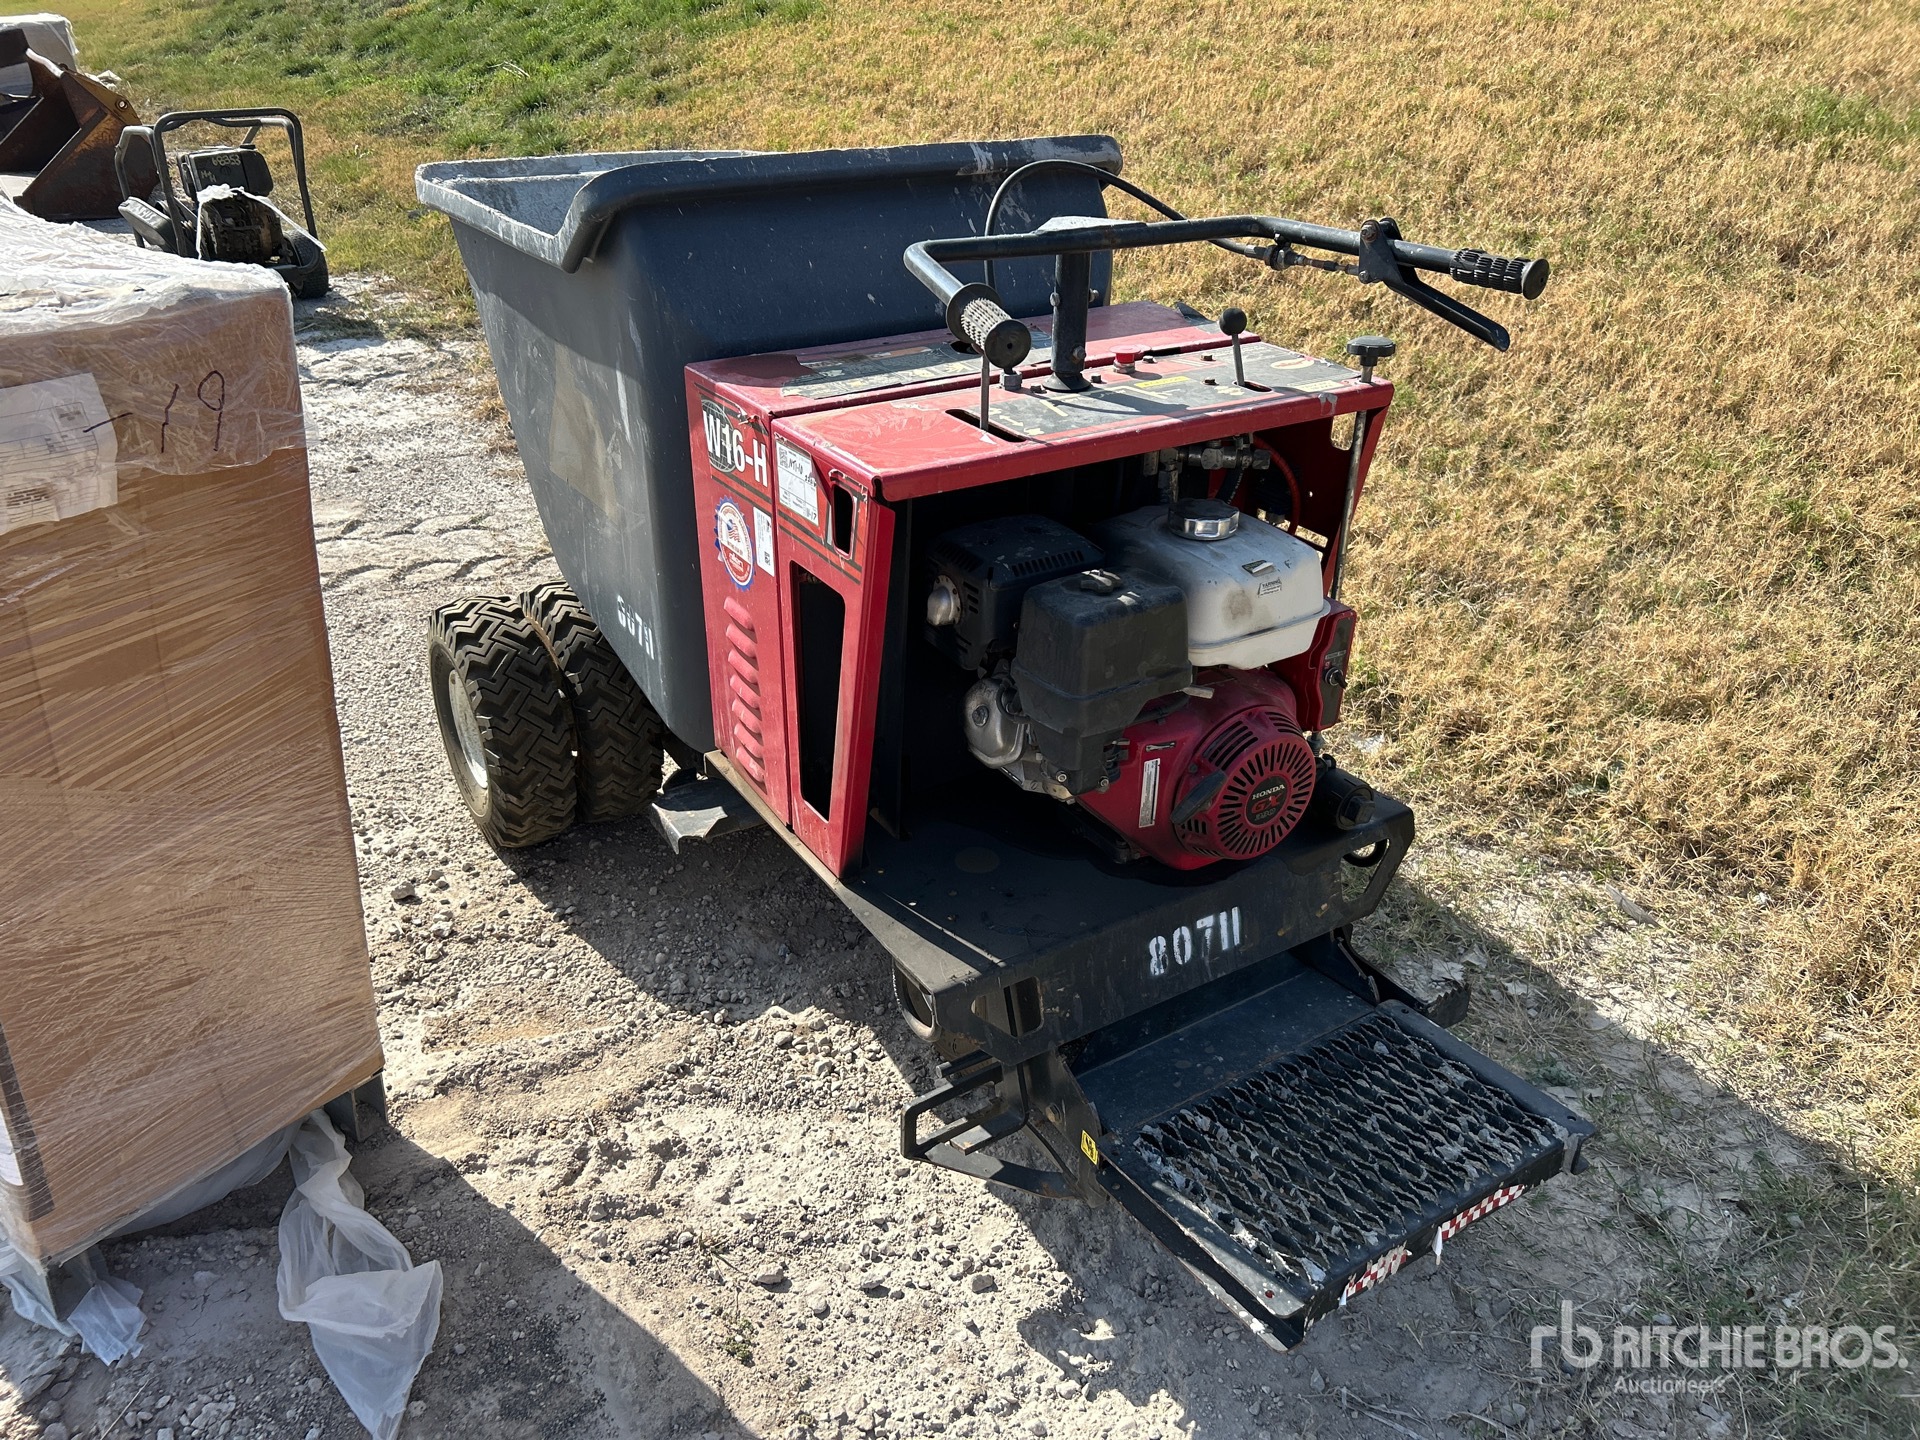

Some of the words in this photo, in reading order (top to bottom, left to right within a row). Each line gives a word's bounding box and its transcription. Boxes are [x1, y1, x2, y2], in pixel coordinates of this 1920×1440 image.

[702, 410, 768, 487] W16-H
[1251, 792, 1282, 814] GX
[1252, 784, 1285, 800] HONDA
[1149, 906, 1240, 975] 80711
